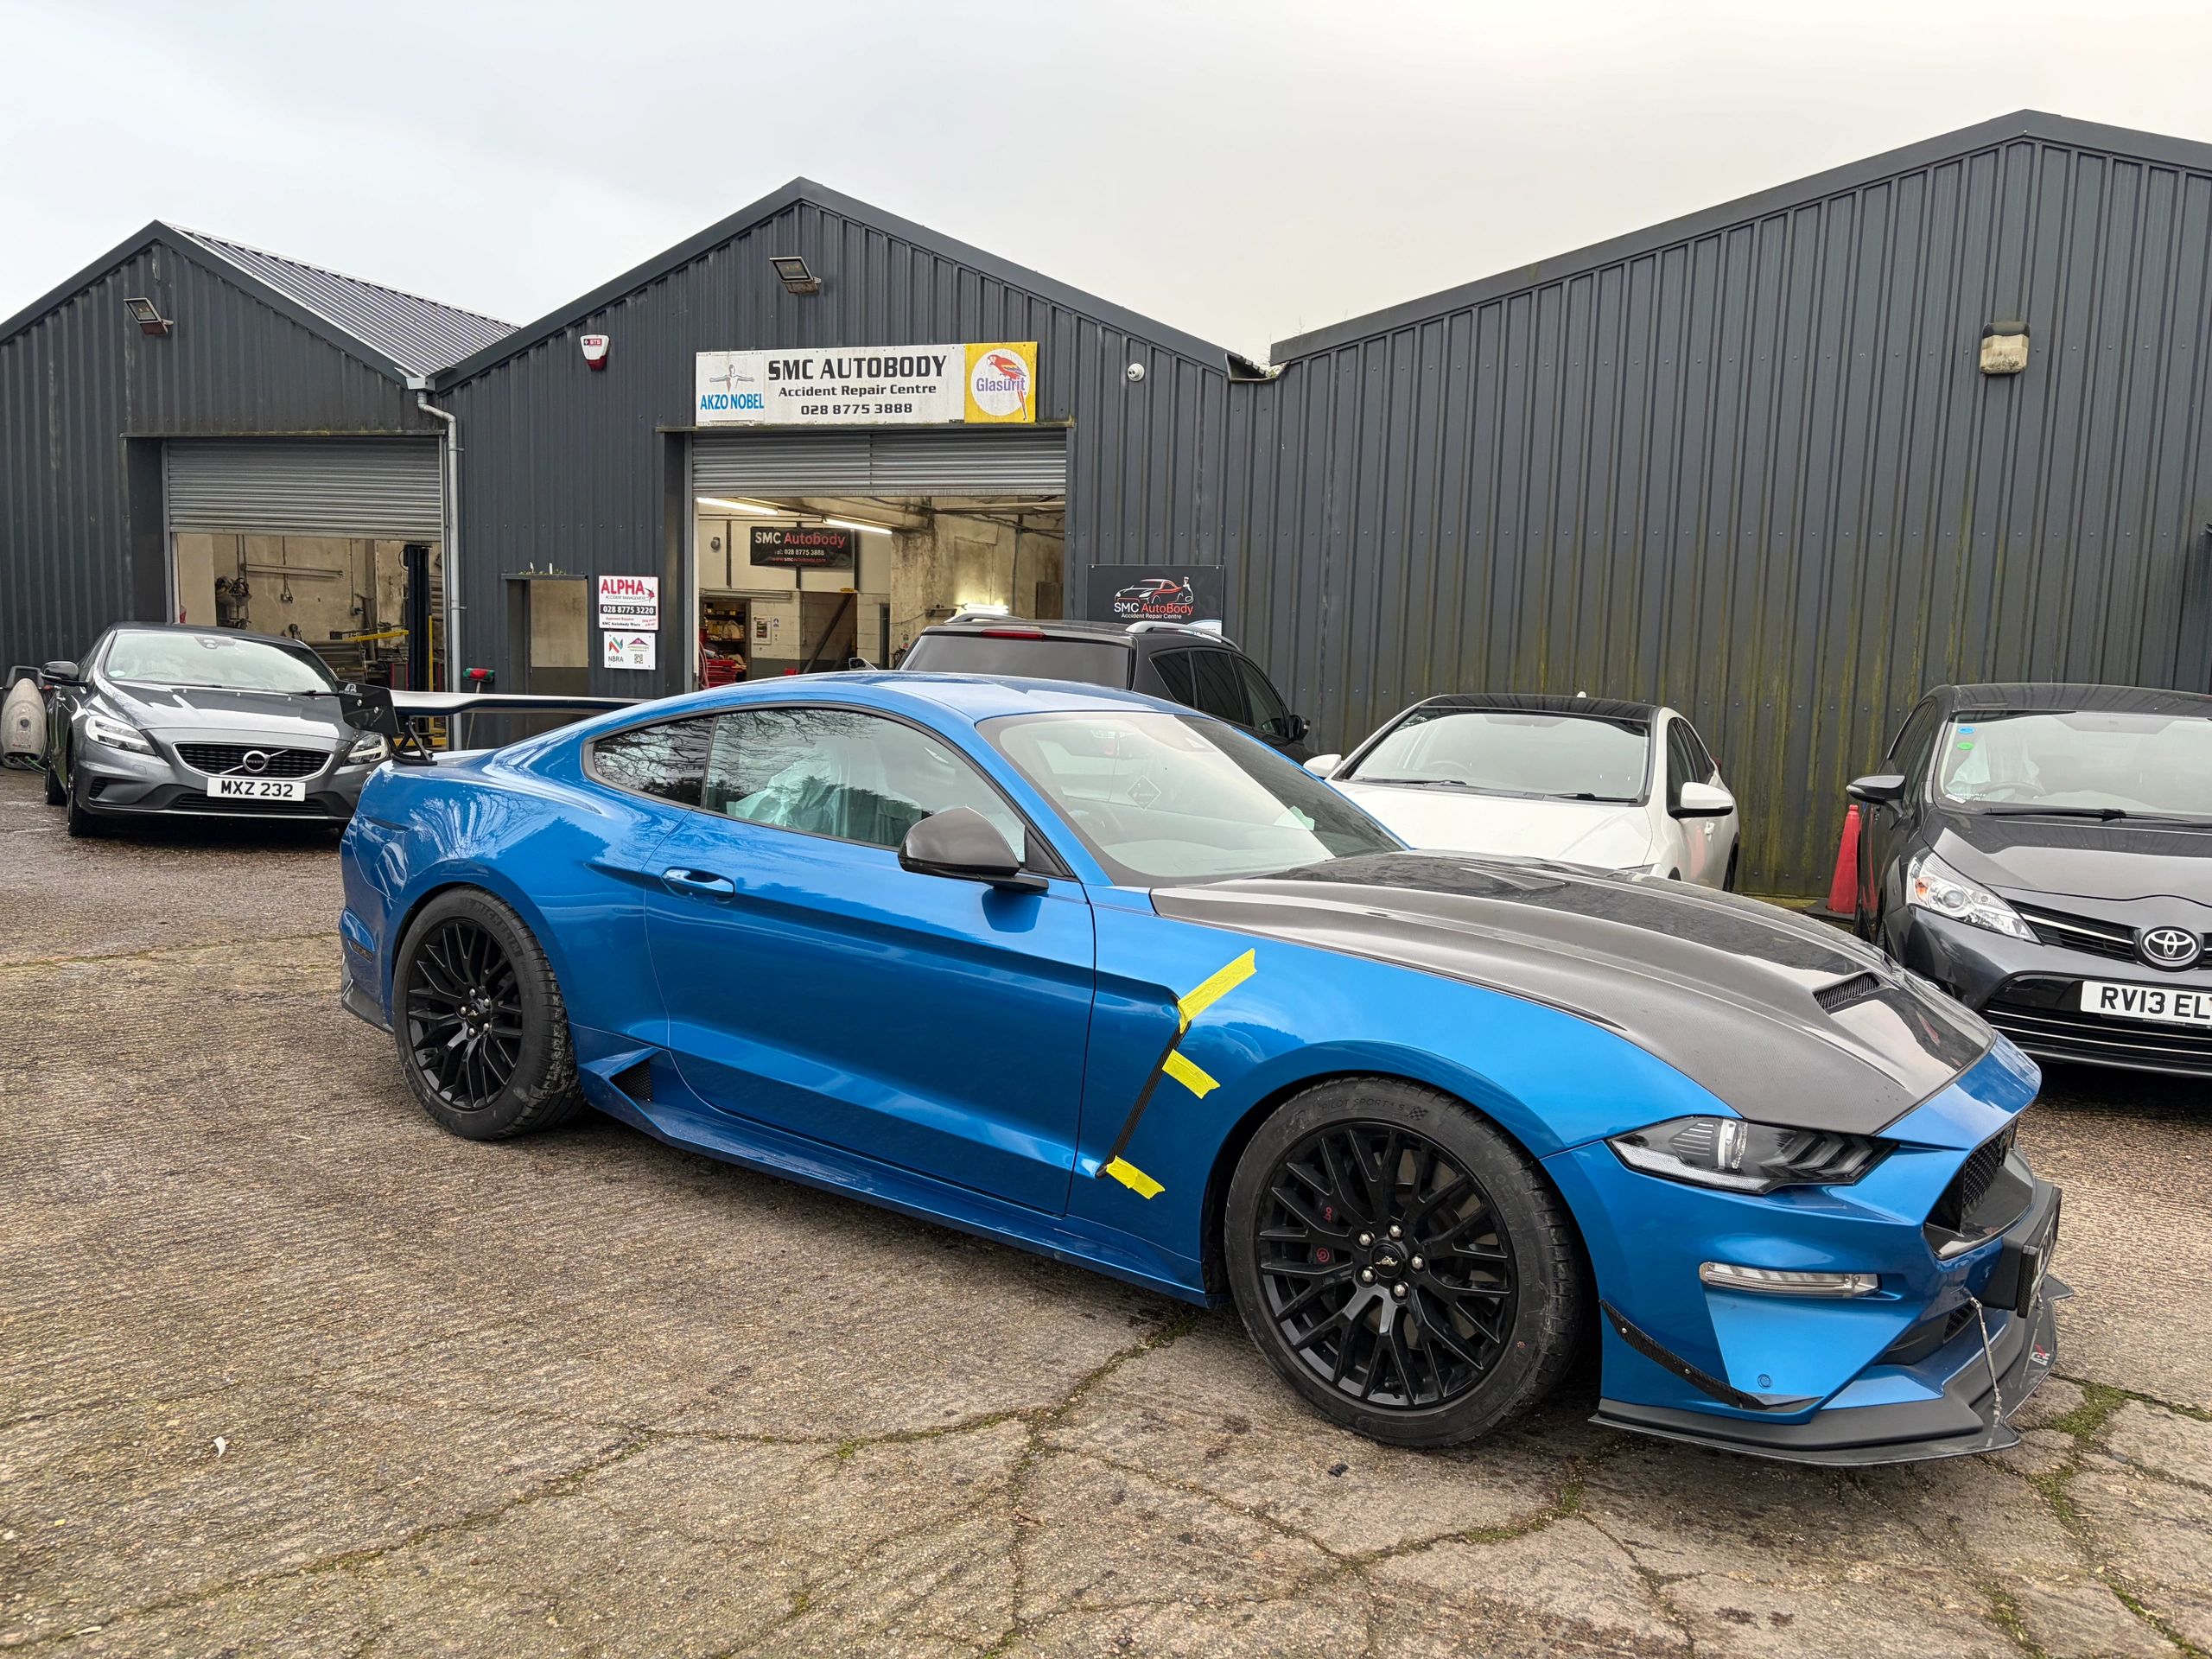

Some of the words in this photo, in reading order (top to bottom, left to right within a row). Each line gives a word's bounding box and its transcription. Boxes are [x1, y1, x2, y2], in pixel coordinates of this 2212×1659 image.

[768, 359, 814, 381] SMC
[819, 355, 947, 379] AUTOBODY
[779, 384, 837, 397] Accident
[841, 384, 887, 397] Repair
[890, 382, 937, 395] Centre
[976, 377, 1025, 391] Glasurit
[700, 394, 729, 410] AKZO
[731, 392, 764, 410] NOBEL
[800, 404, 829, 416] 028
[833, 404, 871, 415] 8775
[874, 403, 912, 415] 3888
[755, 531, 781, 544] SMC
[784, 532, 847, 548] Autobody
[601, 579, 645, 594] ALPHA
[603, 605, 616, 613] 028
[1114, 602, 1139, 613] SMC
[1141, 603, 1193, 615] AutoBody
[221, 779, 255, 795] MXZ
[260, 783, 294, 798] 232
[2100, 987, 2165, 1014] RV13
[2174, 994, 2212, 1020] EL
